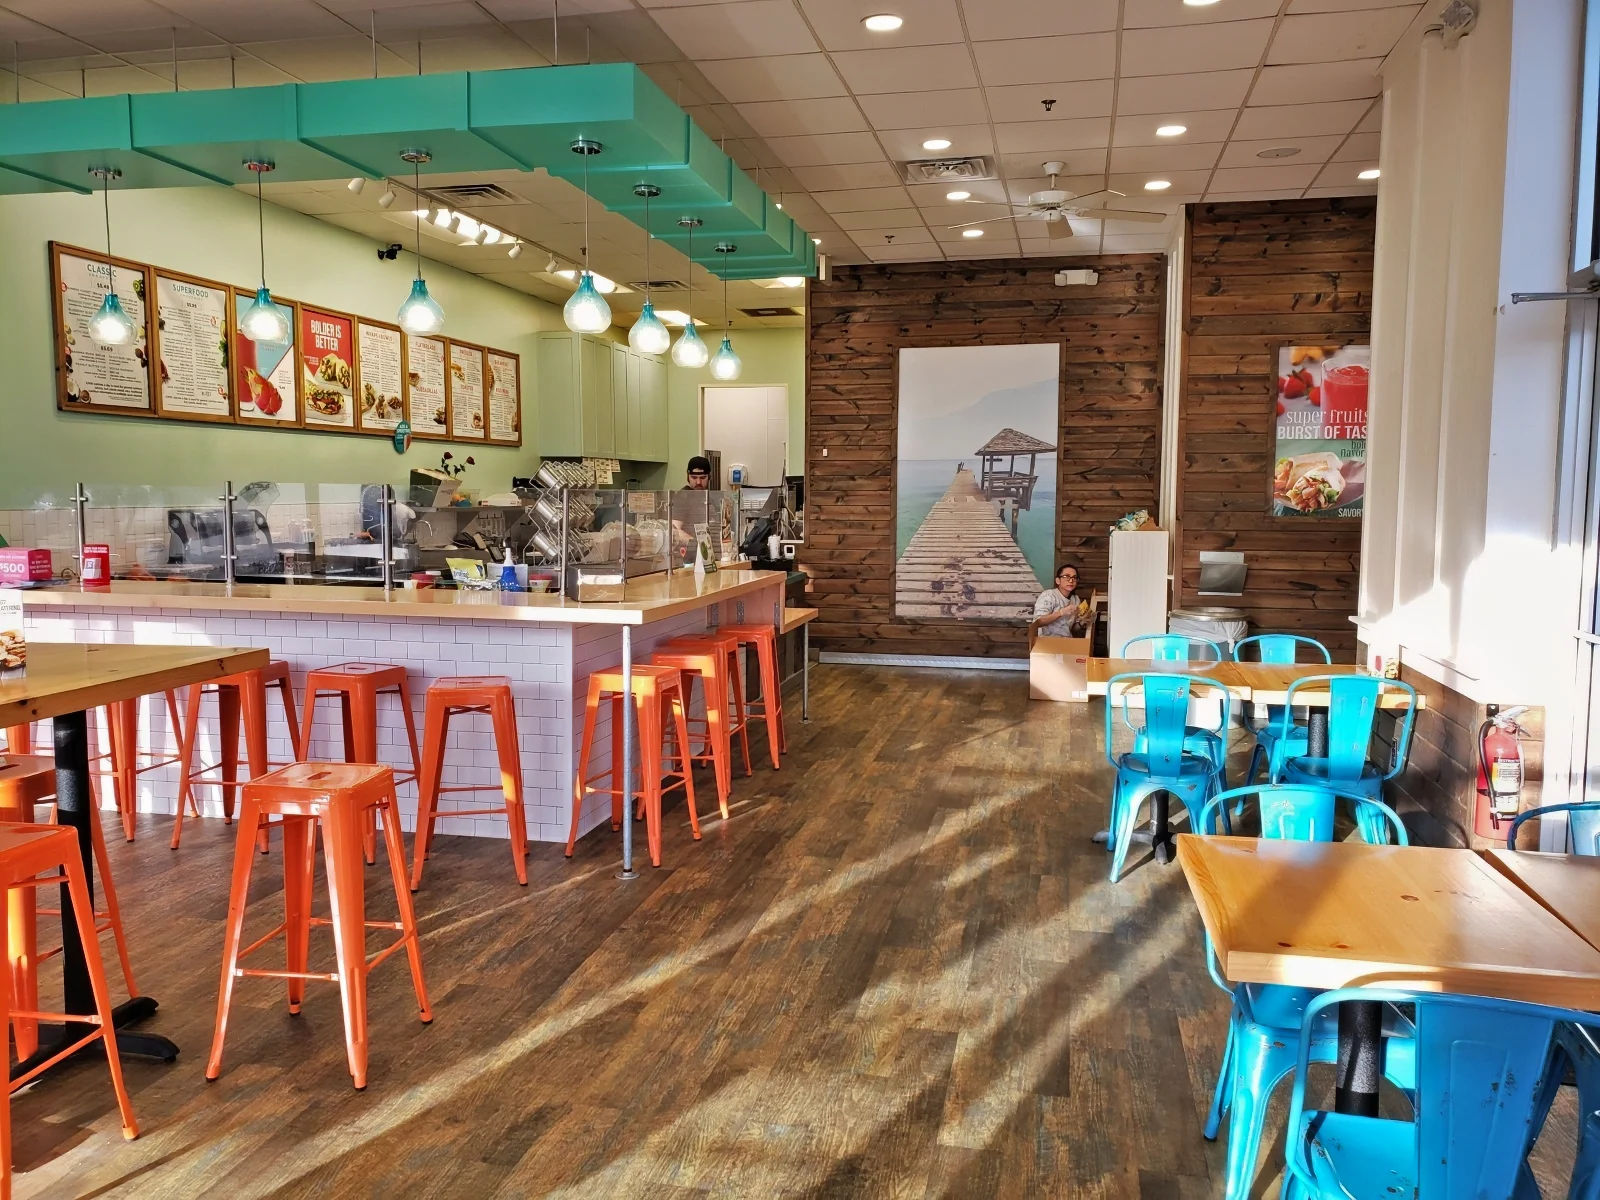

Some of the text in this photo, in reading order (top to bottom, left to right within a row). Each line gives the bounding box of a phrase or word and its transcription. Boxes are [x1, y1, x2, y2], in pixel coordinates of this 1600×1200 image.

[87, 263, 117, 278] CLASSC
[172, 283, 209, 298] SUPERFOOD
[310, 319, 342, 338] BOLDER IS
[315, 334, 339, 352] BETTER
[1286, 410, 1326, 426] super
[1277, 425, 1368, 440] BURST OF TAS
